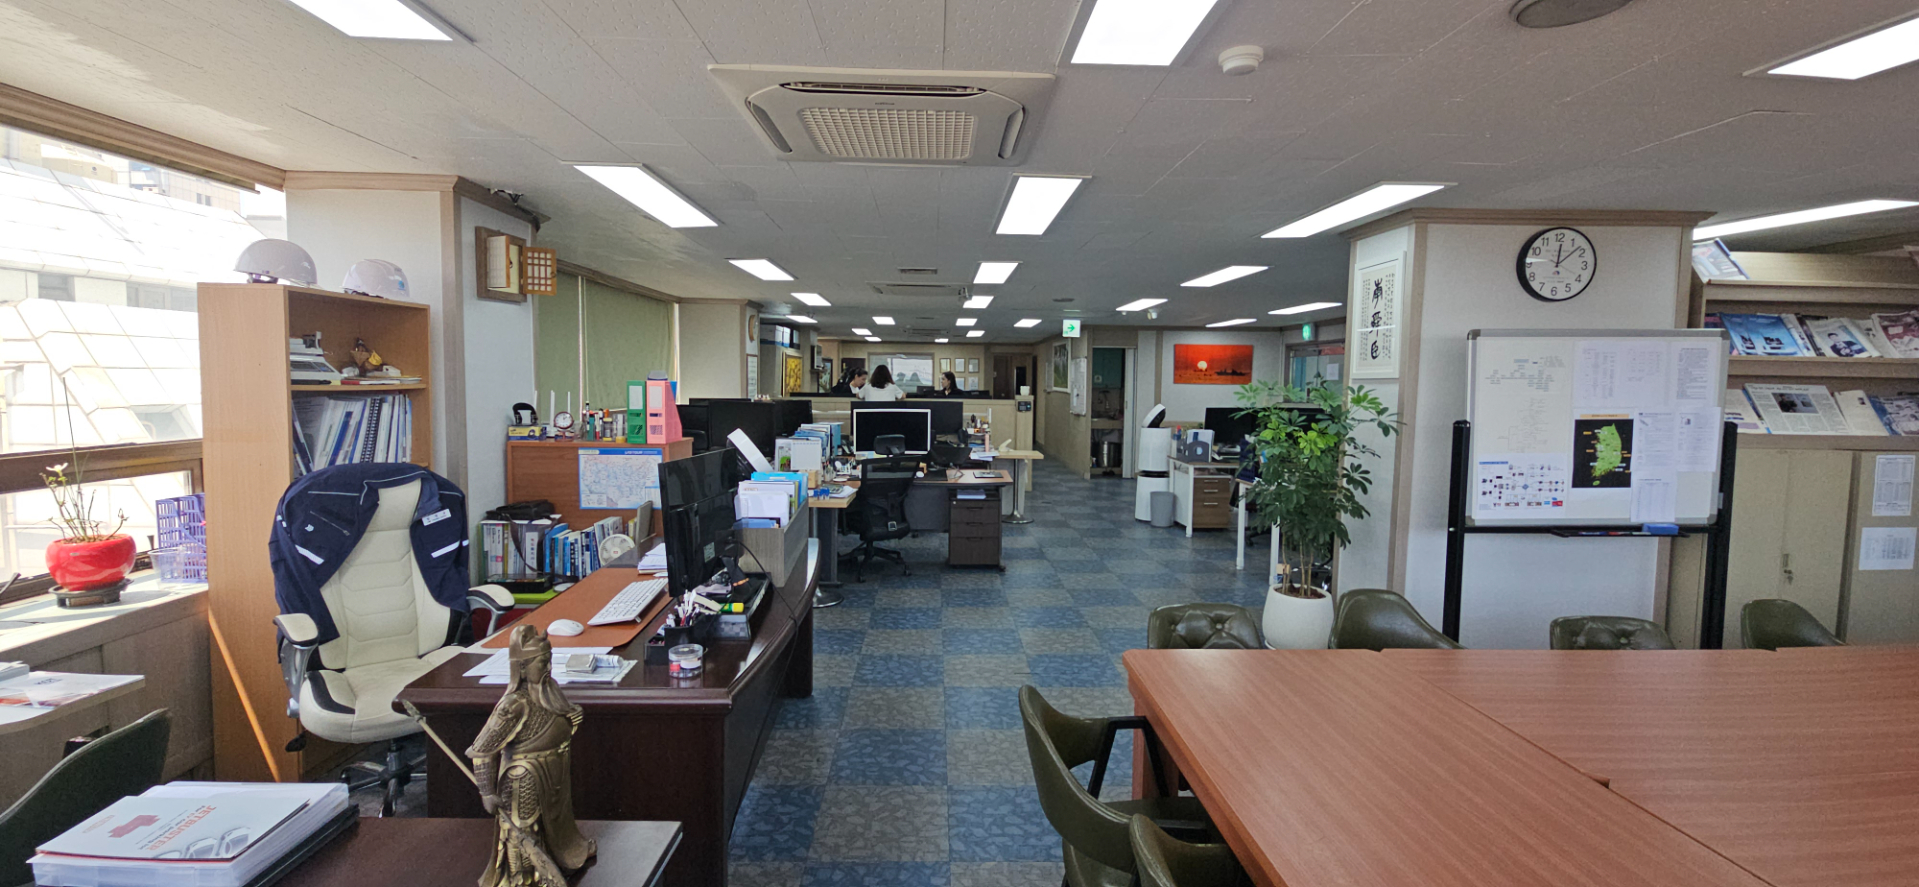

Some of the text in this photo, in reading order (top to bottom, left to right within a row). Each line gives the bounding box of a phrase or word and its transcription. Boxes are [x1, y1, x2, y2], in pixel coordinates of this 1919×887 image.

[1541, 237, 1549, 246] 11
[1555, 232, 1565, 242] 12
[1531, 246, 1541, 256] 10
[1578, 248, 1585, 258] 2
[1581, 261, 1588, 270] 3
[1529, 272, 1535, 281] 8
[1575, 274, 1581, 283] 4
[1539, 282, 1545, 291] 7
[1565, 283, 1571, 292] 5
[1551, 287, 1557, 296] 6
[145, 805, 217, 851] JETBUSTER
